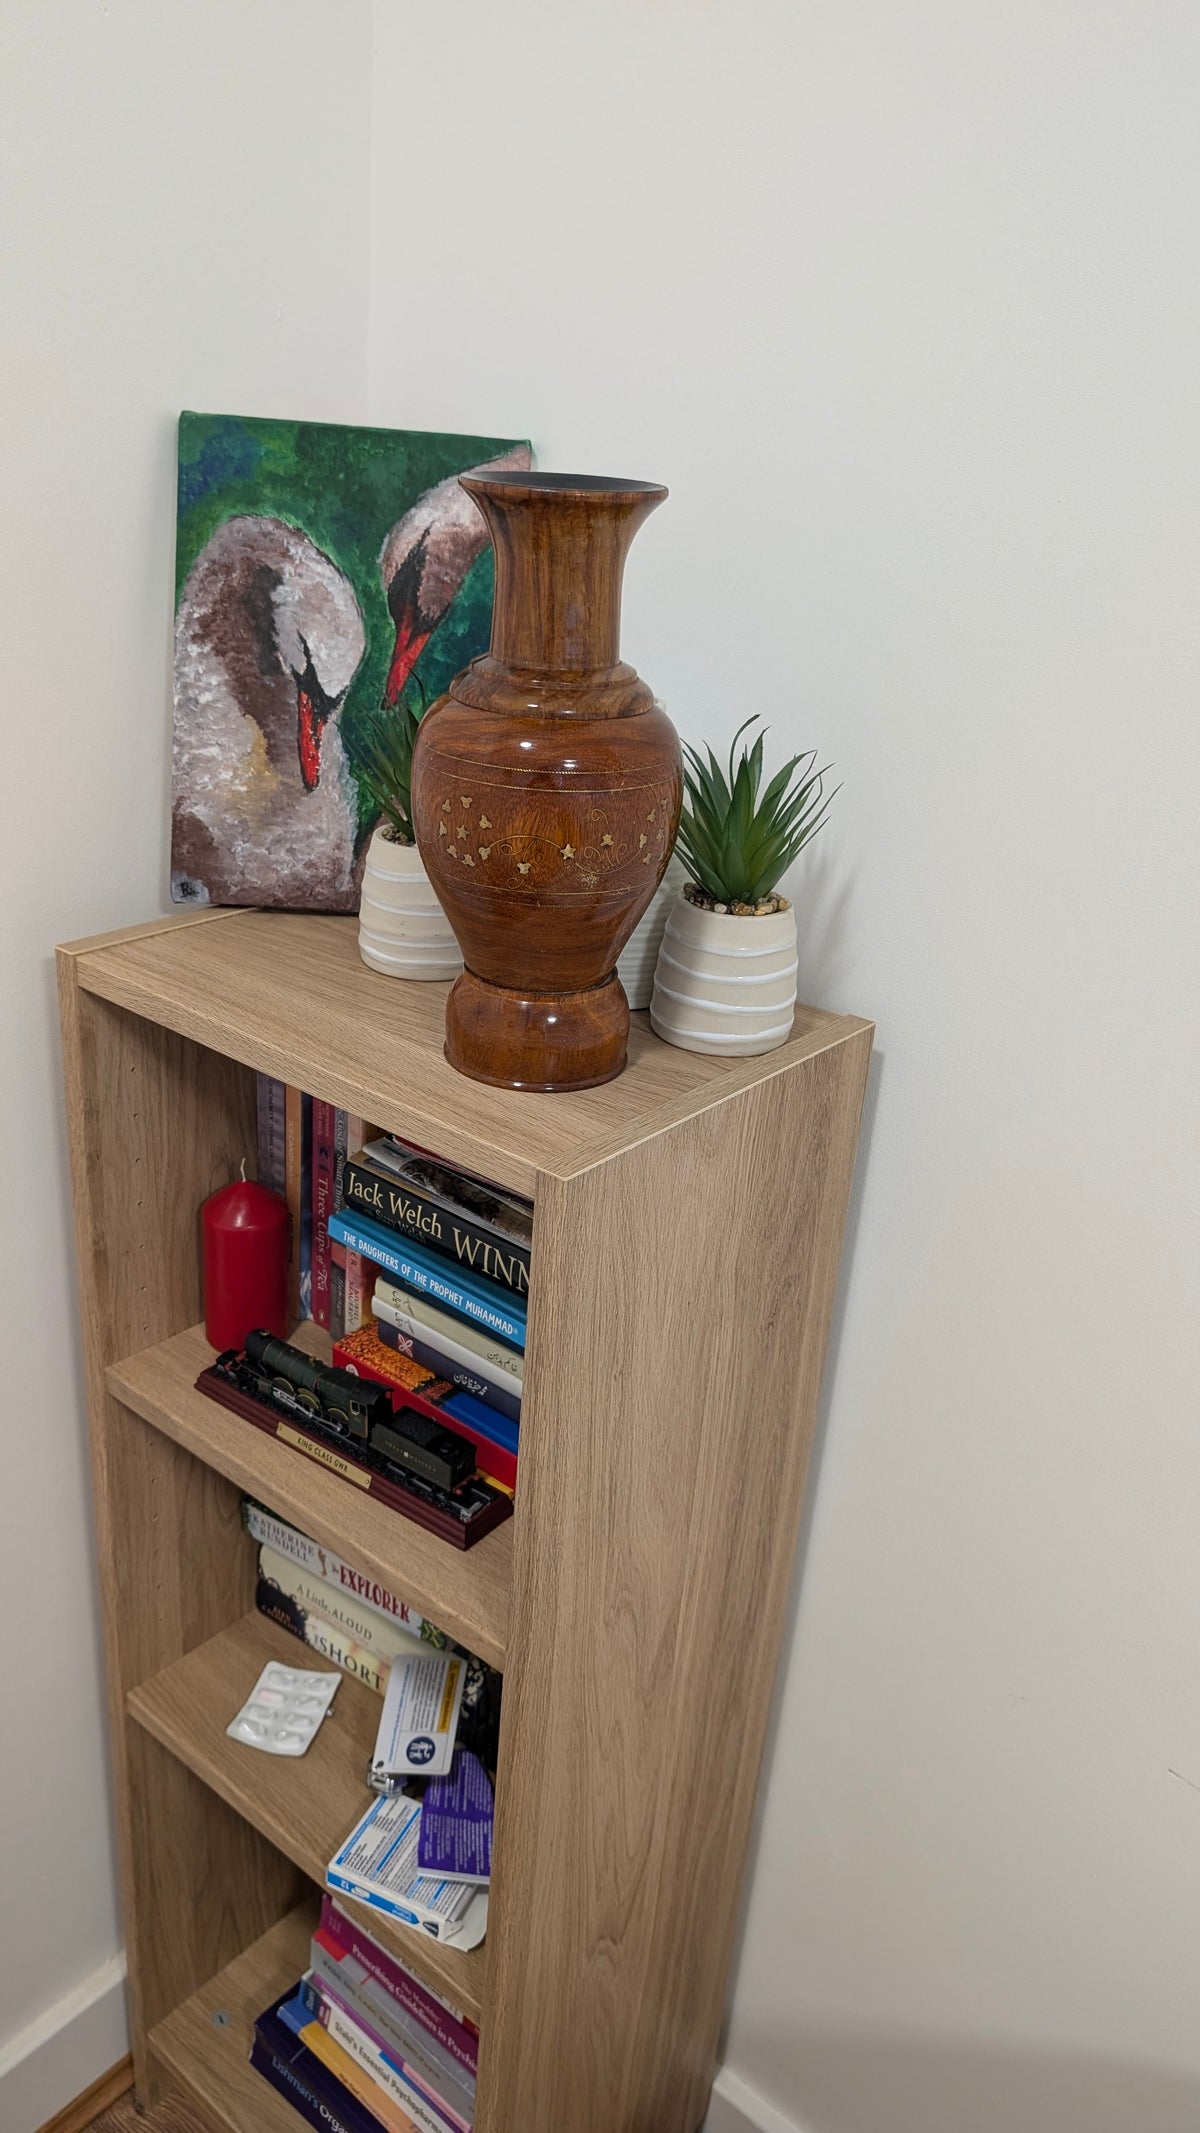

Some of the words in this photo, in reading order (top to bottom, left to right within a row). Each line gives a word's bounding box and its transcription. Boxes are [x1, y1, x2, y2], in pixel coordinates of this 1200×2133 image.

[318, 1178, 329, 1217] Three
[348, 1171, 384, 1209] Jack
[389, 1191, 443, 1240] Welch
[316, 1222, 330, 1253] Cups
[316, 1255, 326, 1269] of
[317, 1269, 328, 1292] Tea
[343, 1230, 357, 1247] THE
[358, 1236, 400, 1271] DAUGHTERS
[401, 1263, 412, 1278] OF
[413, 1269, 428, 1287] THE
[429, 1278, 464, 1306] PROPHET
[465, 1299, 514, 1336] MUHAMMAD
[296, 1436, 314, 1453] KING
[313, 1443, 335, 1466] CLASS
[334, 1457, 350, 1473] GWR
[258, 1526, 310, 1564] RUNDELL
[338, 1564, 412, 1625] EXPLORER
[330, 1607, 374, 1642] ALOUD
[319, 1636, 386, 1690] SHORT
[339, 1877, 351, 1891] 12
[351, 1943, 397, 1993] Prescribing
[393, 1986, 438, 2031] Guidelines
[435, 2027, 449, 2042] in
[270, 2054, 320, 2109] Lishman's
[356, 2047, 392, 2083] Essential
